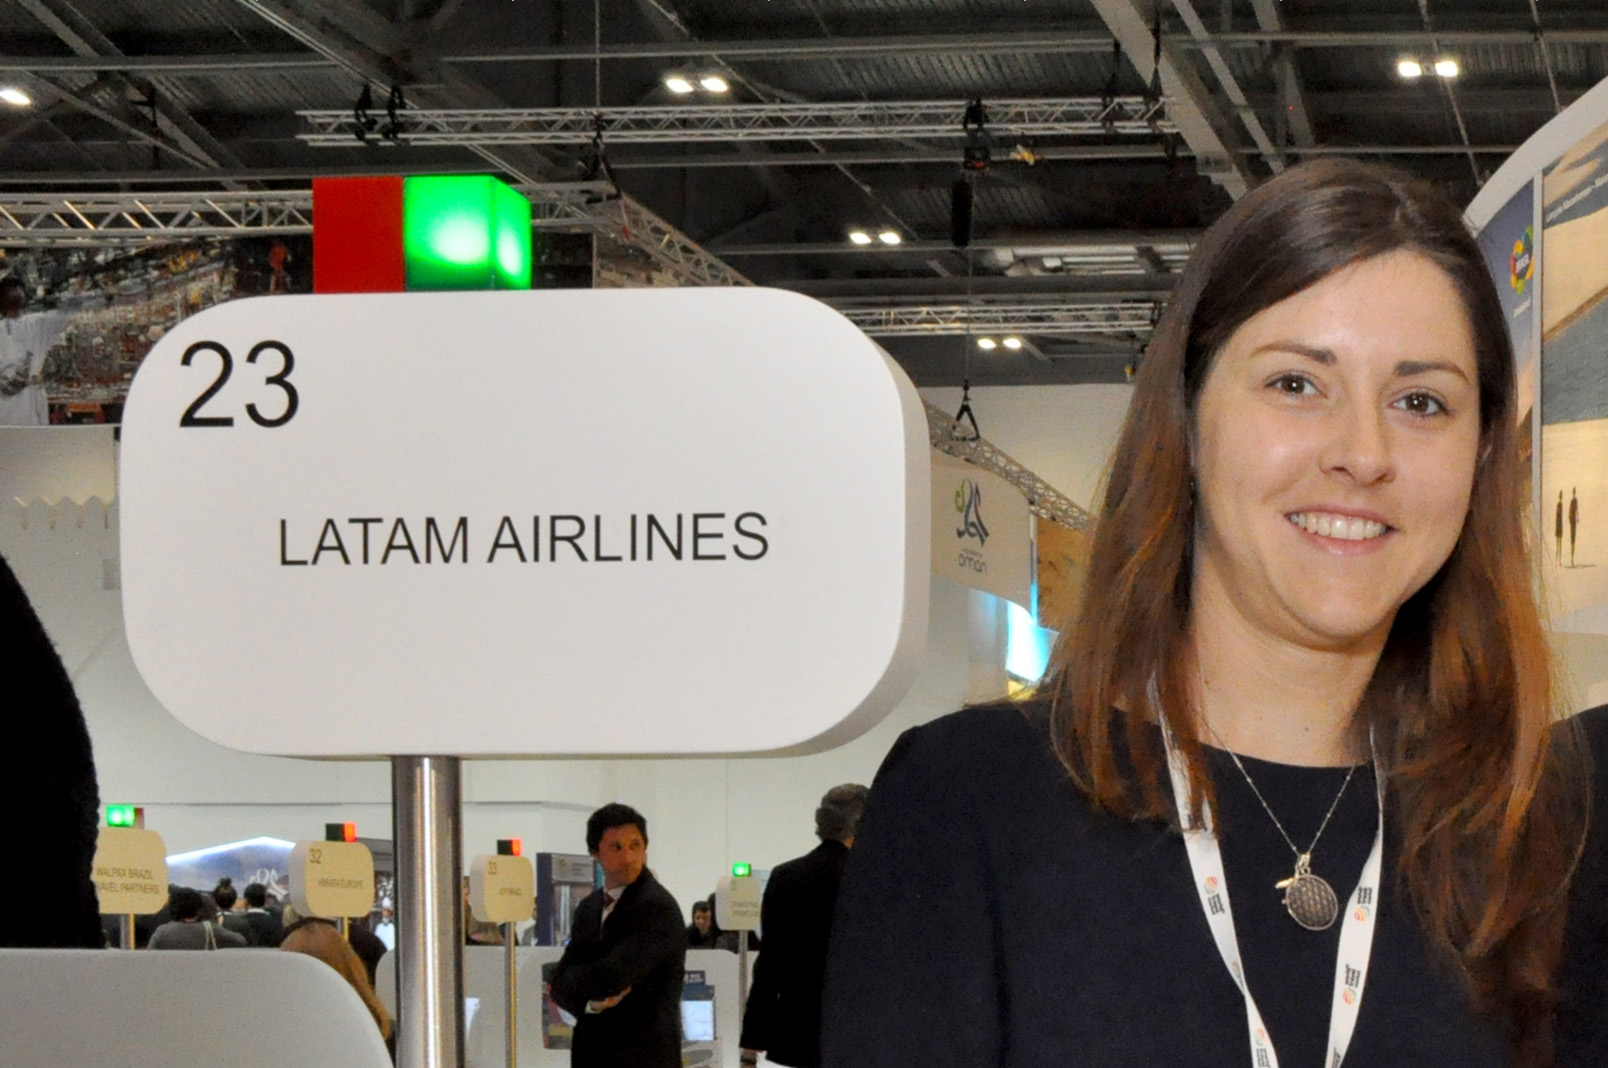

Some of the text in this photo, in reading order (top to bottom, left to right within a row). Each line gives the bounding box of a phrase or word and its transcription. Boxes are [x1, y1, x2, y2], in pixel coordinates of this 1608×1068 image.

[179, 341, 300, 428] 23
[279, 513, 770, 566] LATAM AIRLINES
